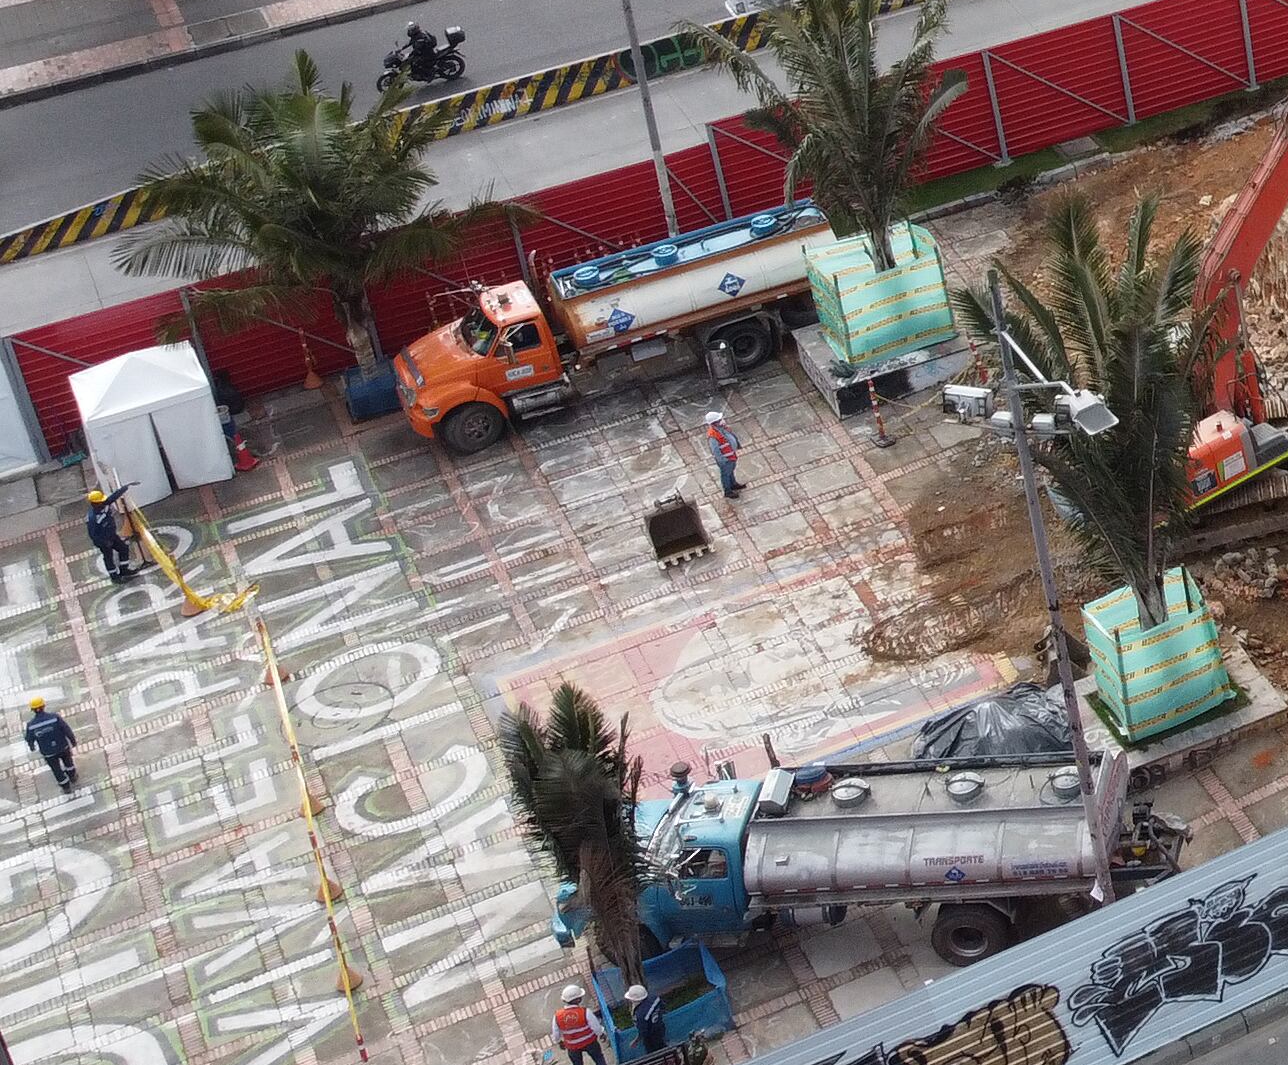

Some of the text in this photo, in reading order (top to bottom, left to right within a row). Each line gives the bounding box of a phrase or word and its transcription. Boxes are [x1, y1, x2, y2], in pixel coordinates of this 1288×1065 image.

[148, 712, 279, 839] EL
[226, 458, 560, 1011] NACIONAL
[923, 854, 985, 867] TRANSPORTE
